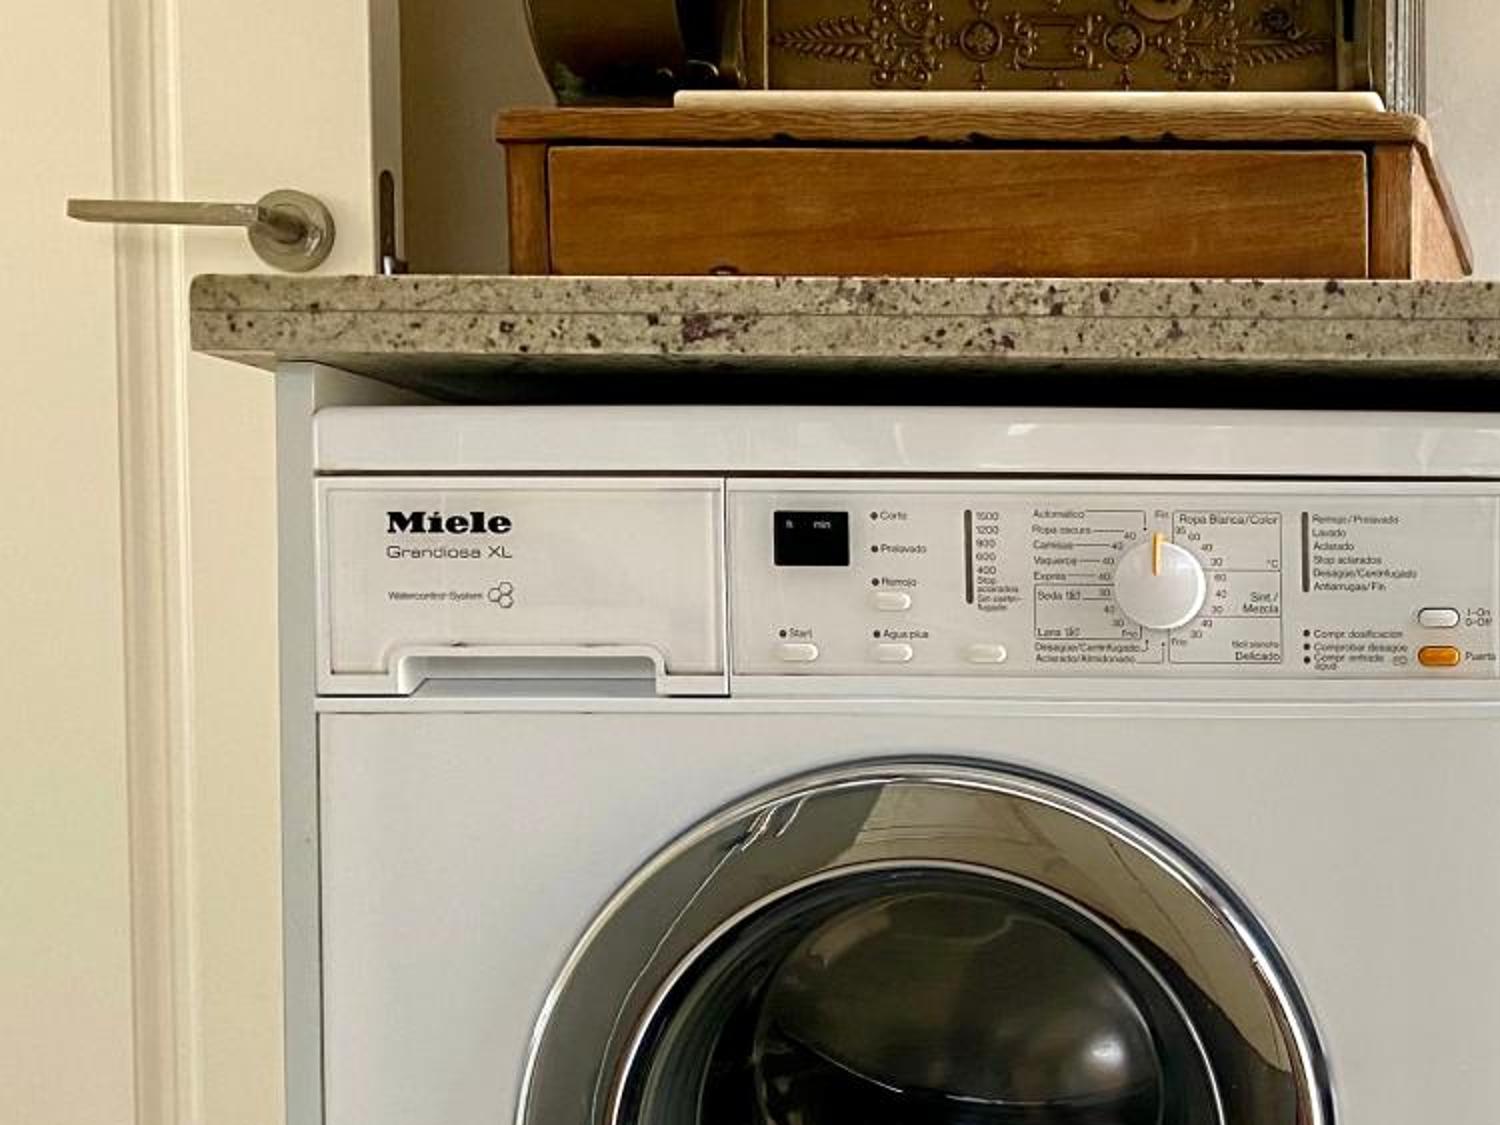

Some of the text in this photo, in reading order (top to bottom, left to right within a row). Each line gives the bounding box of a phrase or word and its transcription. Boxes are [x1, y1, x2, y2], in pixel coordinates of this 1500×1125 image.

[880, 511, 907, 521] Corto
[1180, 513, 1278, 525] Ropa Blanca/Color
[387, 511, 512, 534] Miele
[813, 519, 832, 529] min
[1312, 528, 1347, 538] Lavado
[880, 543, 927, 553] Prelavado
[1314, 541, 1355, 551] Aclarado
[386, 545, 513, 559] Grandiosa XL
[1338, 555, 1382, 564] aclarados
[977, 565, 997, 575] 400
[882, 577, 917, 587] Remojo
[789, 627, 813, 638] Start
[883, 629, 907, 641] Agua
[1466, 651, 1496, 662] Puerta
